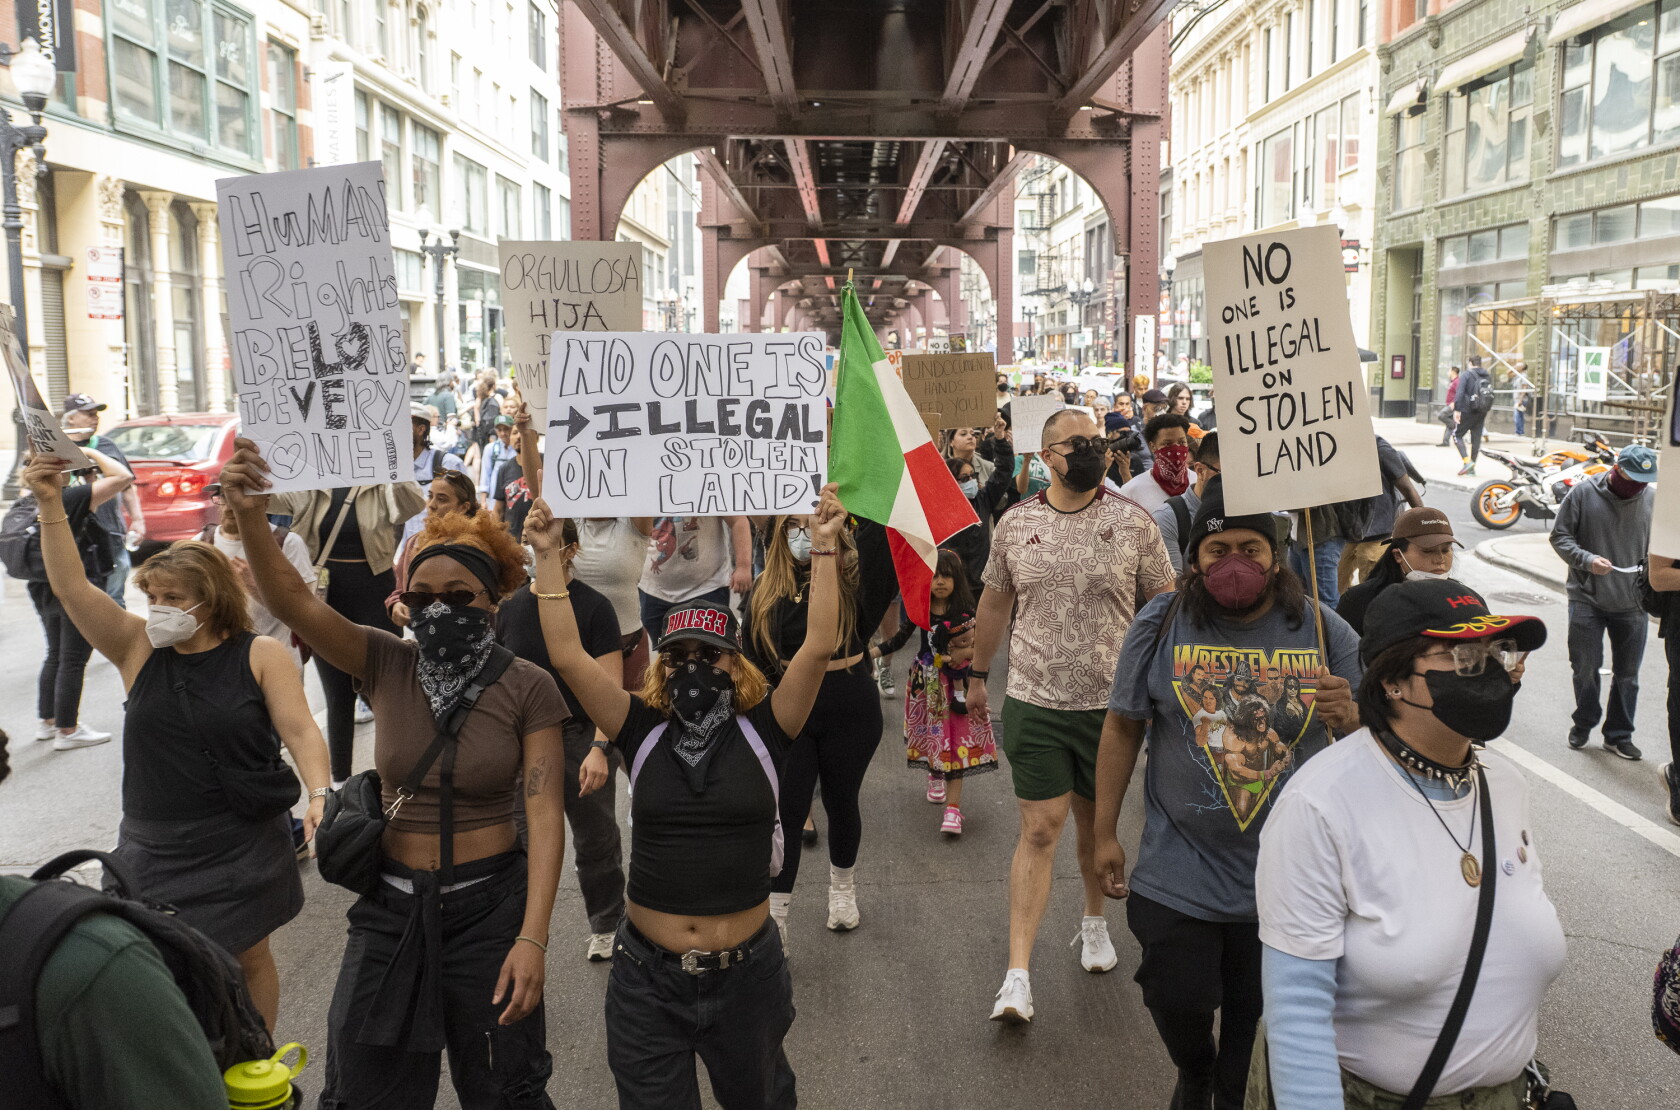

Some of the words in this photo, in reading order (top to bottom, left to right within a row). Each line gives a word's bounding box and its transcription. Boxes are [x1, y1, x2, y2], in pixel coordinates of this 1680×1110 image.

[38, 0, 56, 64] DIAMOND
[328, 129, 340, 164] WAN
[504, 253, 639, 294] ORGULLOSA
[1243, 242, 1291, 289] NO
[530, 299, 609, 331] HIJA
[1105, 278, 1113, 322] AVENUE
[1222, 296, 1260, 324] ONE
[1279, 287, 1296, 312] IS
[235, 320, 406, 386] BELONG
[559, 338, 634, 397] NO
[650, 340, 754, 398] ONE
[763, 335, 827, 399] IS
[1105, 330, 1113, 365] ABASH
[1225, 318, 1331, 376] ILLEGAL
[1262, 369, 1292, 389] ON
[593, 398, 824, 443] ILLEGAL
[1236, 381, 1354, 435] STOLEN
[266, 430, 398, 480] ONE!
[557, 445, 627, 501] ON
[660, 436, 819, 473] STOLEN
[1256, 431, 1338, 478] LAND
[658, 471, 822, 514] LAND!
